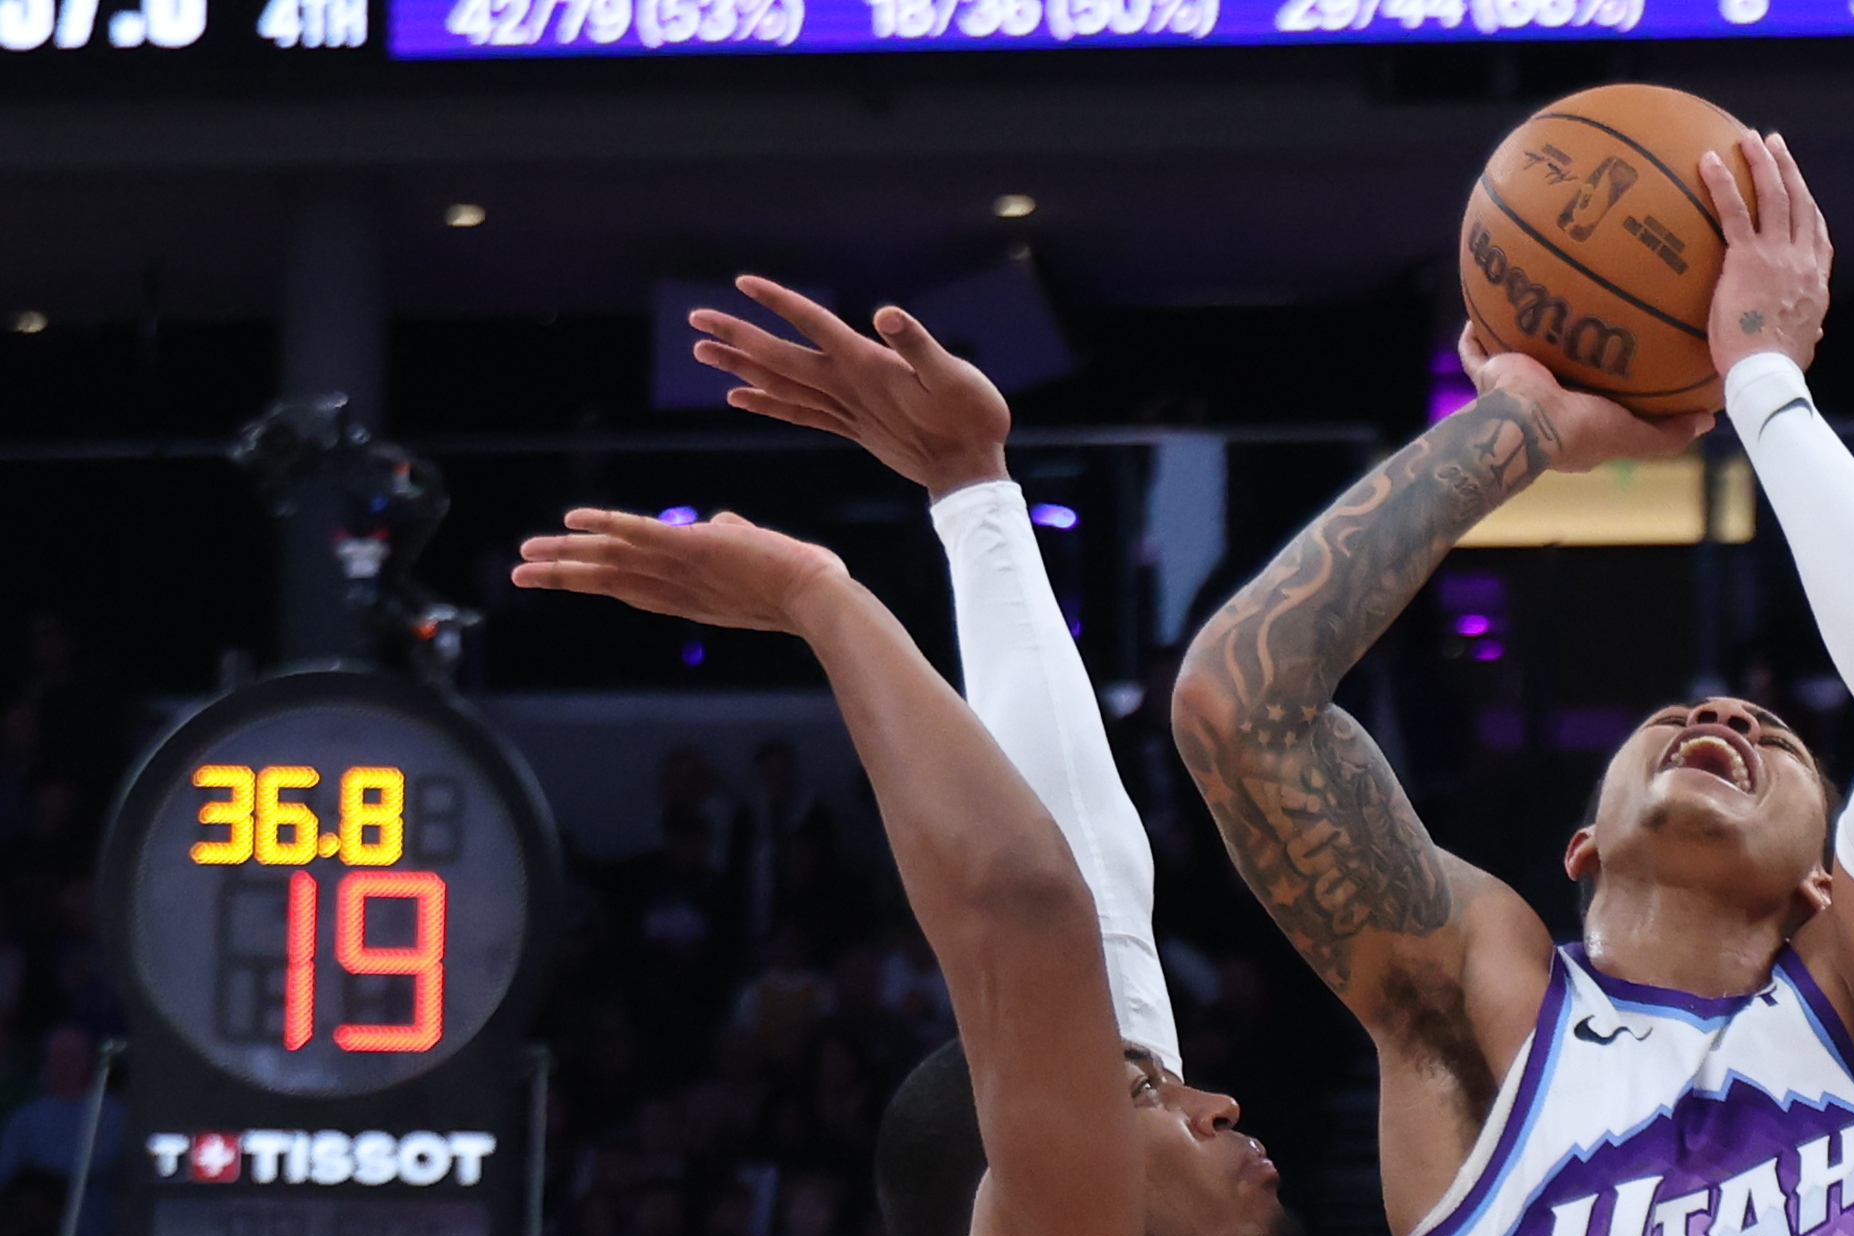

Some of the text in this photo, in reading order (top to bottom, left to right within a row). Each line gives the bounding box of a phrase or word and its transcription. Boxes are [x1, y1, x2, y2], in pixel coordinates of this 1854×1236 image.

[190, 765, 405, 866] 36.8
[283, 870, 447, 1052] 19
[243, 1129, 497, 1187] TISSOT
